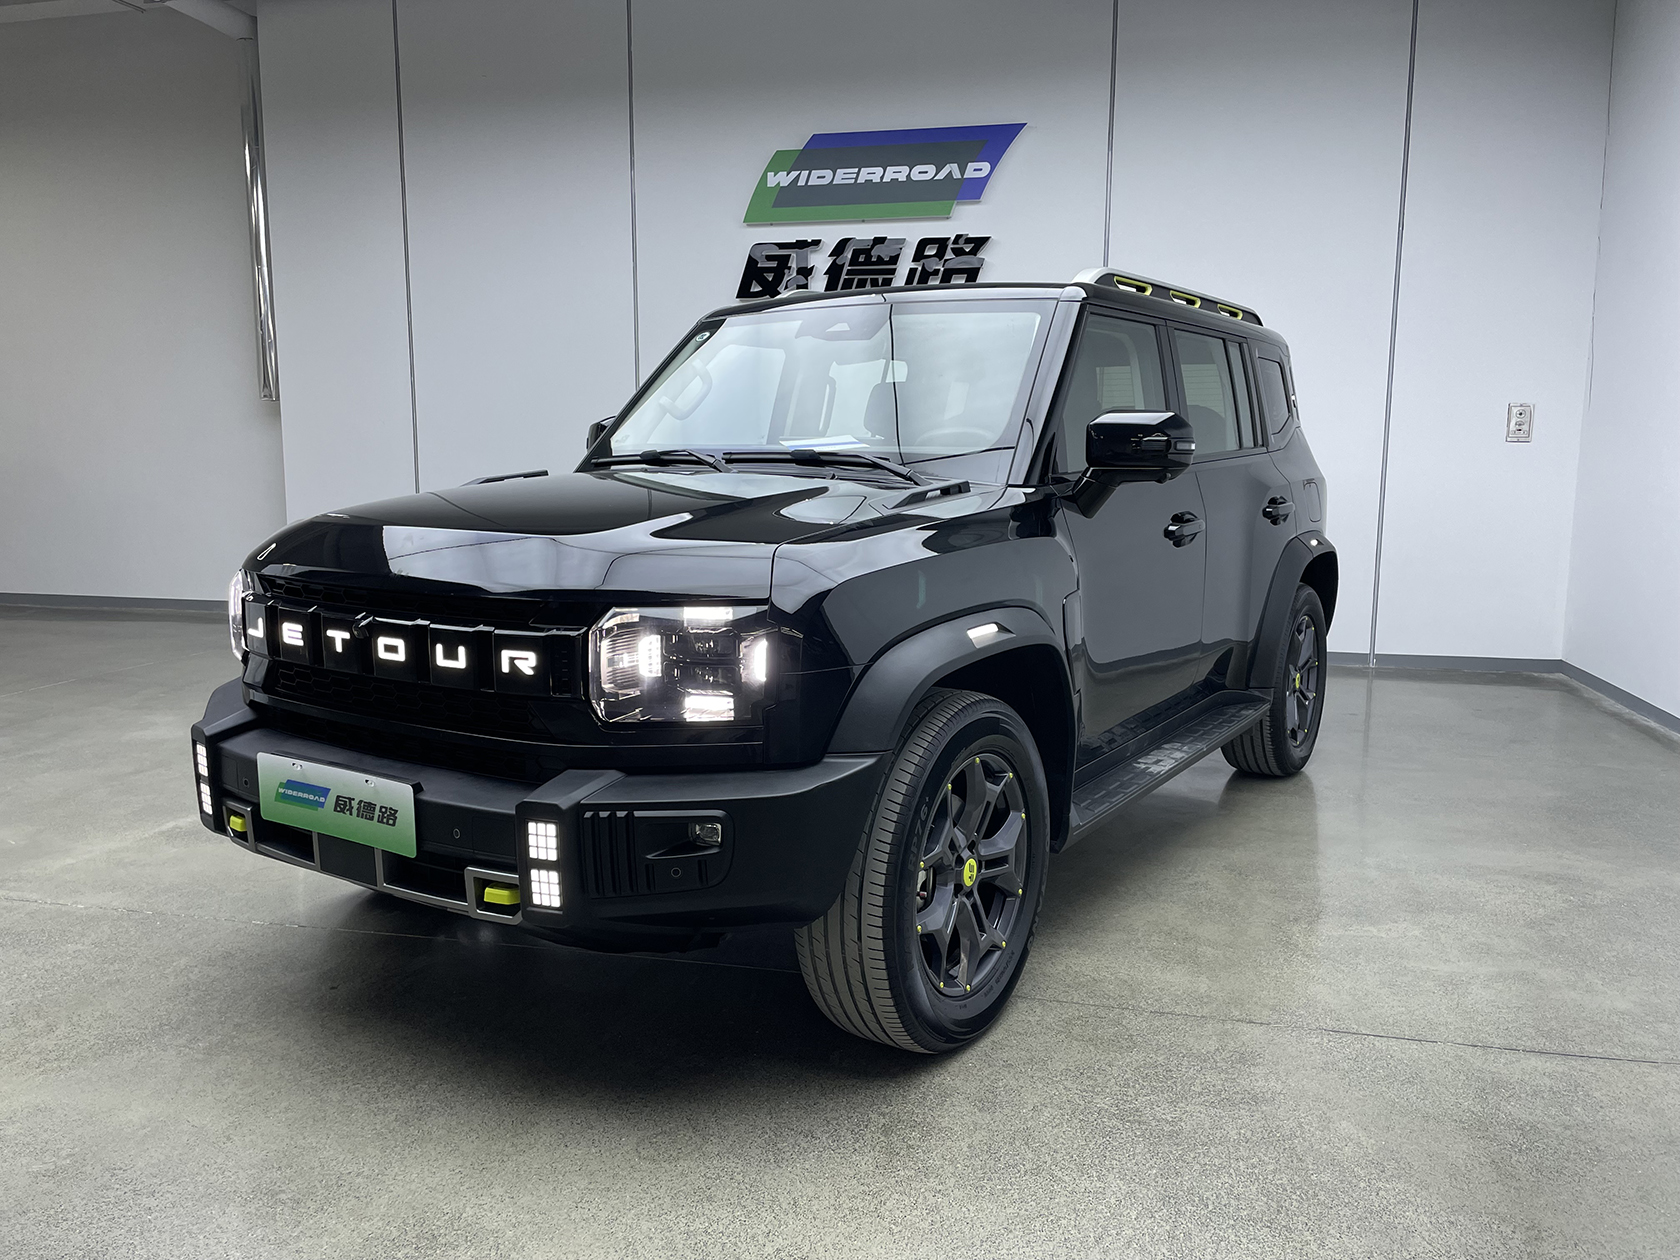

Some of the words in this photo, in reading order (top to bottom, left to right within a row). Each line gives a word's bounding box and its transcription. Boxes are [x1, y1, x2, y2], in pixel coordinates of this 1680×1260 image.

[766, 161, 991, 187] WIDERROAD
[735, 233, 992, 299] 威德路
[247, 617, 538, 676] JETOUR
[278, 787, 326, 803] WIDERROAD
[333, 794, 399, 827] 威德路
